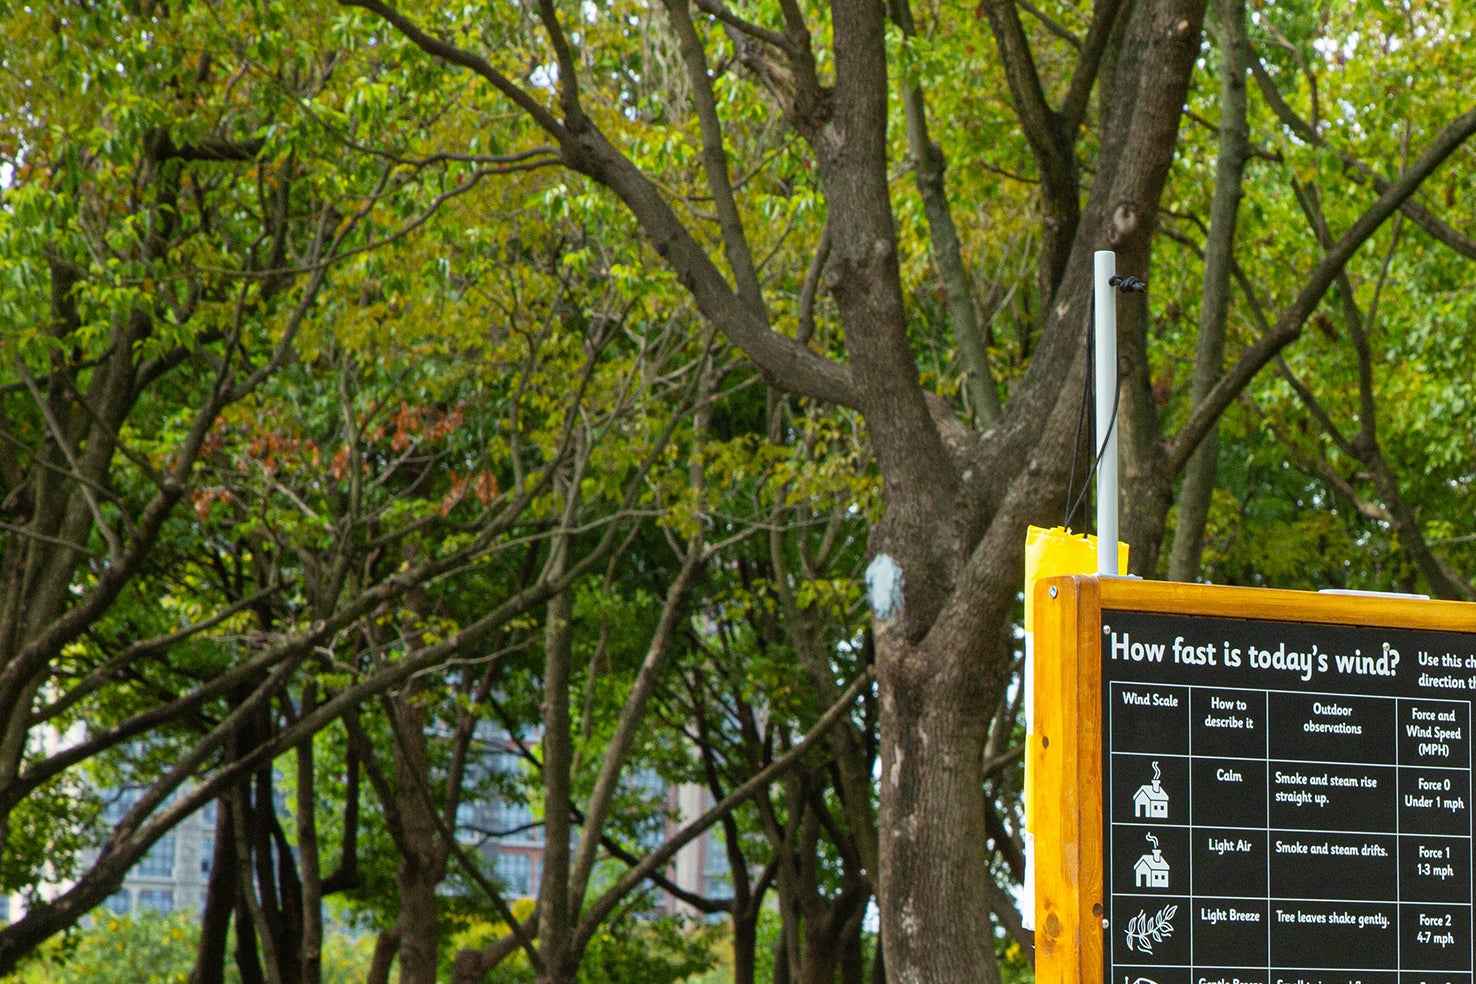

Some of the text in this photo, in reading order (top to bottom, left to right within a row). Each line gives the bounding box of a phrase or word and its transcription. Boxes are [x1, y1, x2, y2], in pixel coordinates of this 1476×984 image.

[1111, 631, 1165, 663] How
[1171, 636, 1217, 666] fast
[1223, 640, 1242, 668] is
[1334, 643, 1400, 677] wind?
[1418, 651, 1440, 667] Use
[1441, 652, 1463, 668] this
[1418, 672, 1467, 689] direction
[1122, 691, 1179, 708] Wind Scale
[1211, 696, 1247, 711] How to
[1312, 701, 1353, 717] Outdoor
[1411, 707, 1456, 722] Force and
[1204, 714, 1254, 729] describe it
[1303, 719, 1362, 735] observations
[1405, 724, 1462, 743] Wind Speed
[1418, 742, 1450, 758] (MPH)
[1216, 768, 1243, 782] Calm
[1275, 771, 1378, 788] Smoke and steam rise
[1418, 777, 1451, 791] Force 0
[1275, 790, 1330, 808] straight up.
[1404, 794, 1465, 813] Under 1 mph
[1208, 837, 1252, 856] Light Air
[1275, 840, 1389, 857] Smoke and steam drifts.
[1418, 845, 1450, 859] Force 1
[1417, 863, 1455, 881] 1-3 mph
[1200, 907, 1261, 925] Light Breeze
[1275, 909, 1390, 929] Tree leaves shake gently.
[1419, 913, 1452, 927] Force 2
[1416, 931, 1455, 948] 4-7 mph
